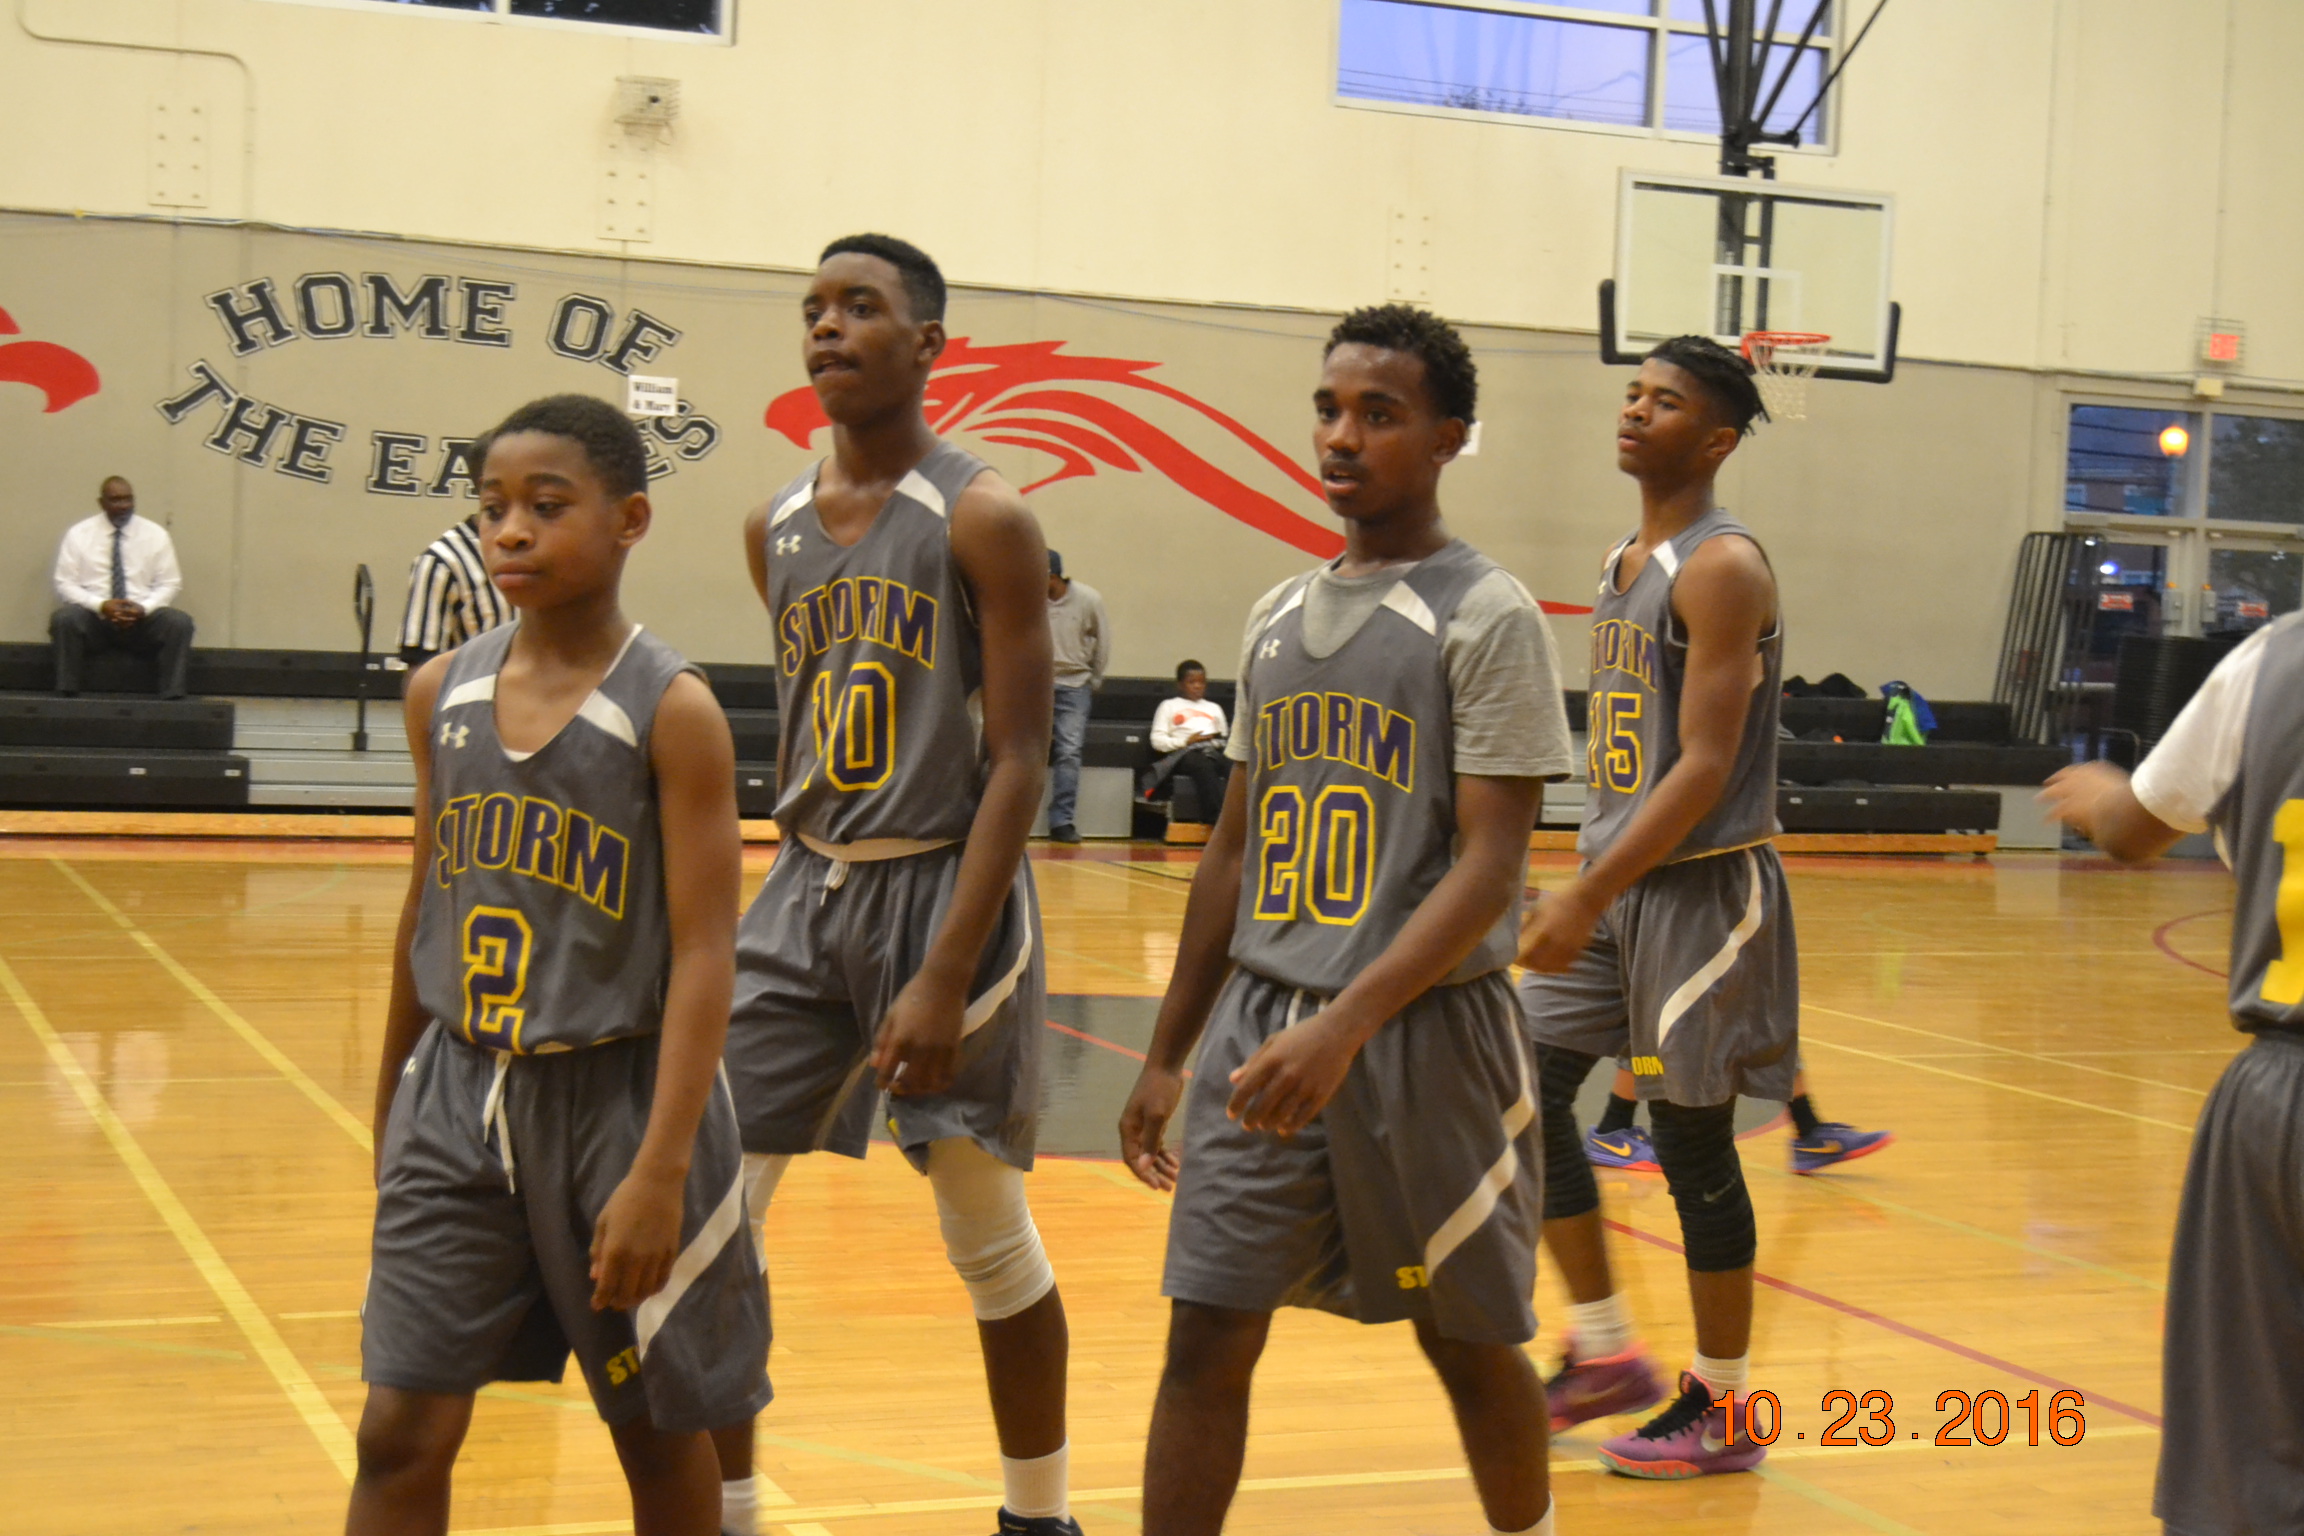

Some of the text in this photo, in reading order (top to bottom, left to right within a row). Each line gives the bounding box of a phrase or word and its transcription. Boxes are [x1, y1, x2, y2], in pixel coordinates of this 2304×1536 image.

[204, 271, 684, 376] HOME OF
[156, 359, 347, 484] THE
[780, 576, 938, 677] STORM
[1590, 618, 1659, 693] TORM
[803, 662, 896, 792] 10
[1252, 691, 1417, 793] TORM
[1586, 691, 1643, 794] 15
[1253, 785, 1376, 926] 20
[462, 904, 533, 1056] 2
